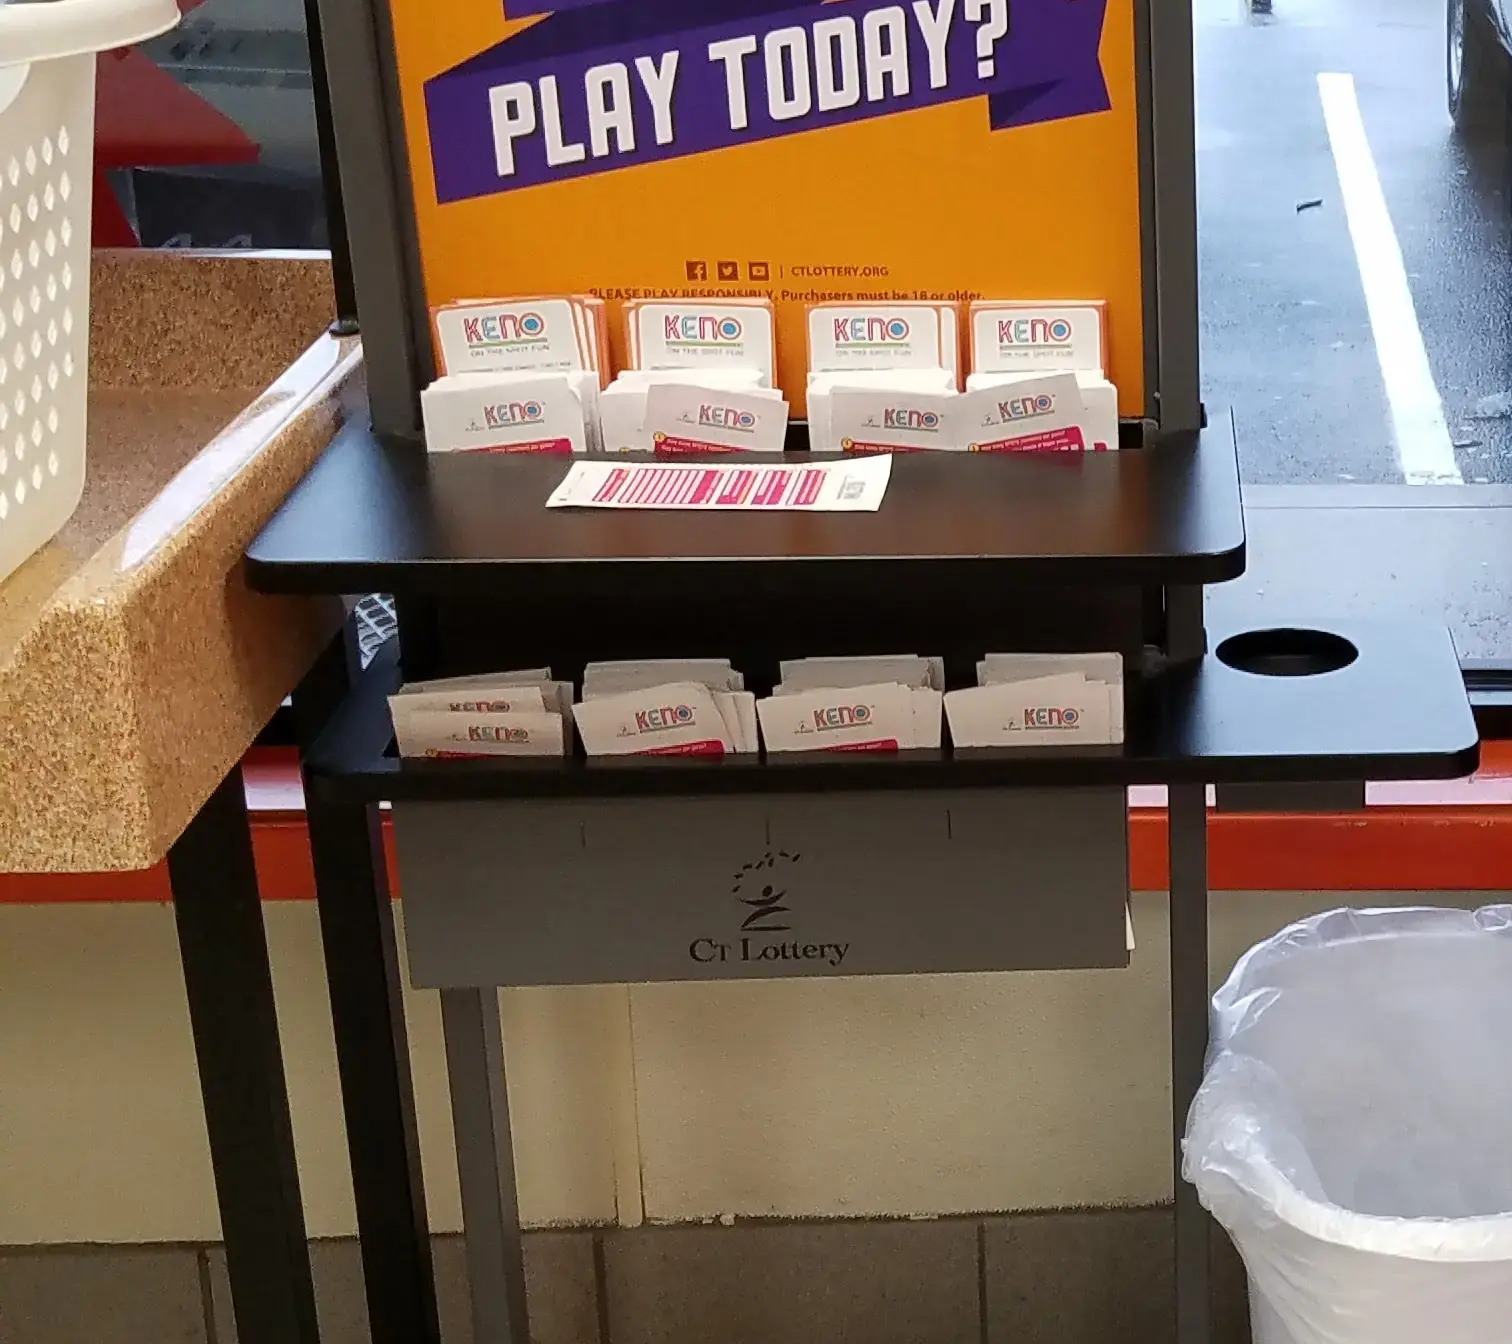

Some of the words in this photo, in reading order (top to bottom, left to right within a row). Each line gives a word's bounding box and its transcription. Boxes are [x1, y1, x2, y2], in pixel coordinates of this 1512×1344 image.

[488, 51, 680, 178] PLAY
[791, 266, 889, 277] CTLOTTERY.ORG
[589, 288, 641, 300] PLEASE
[781, 290, 851, 302] Purchasers
[856, 290, 889, 301] must
[892, 290, 908, 301] be
[912, 290, 928, 300] 18
[947, 289, 985, 301] older.
[463, 312, 544, 343] KENO
[664, 314, 742, 340] KENO
[834, 317, 910, 342] KENO
[998, 318, 1072, 343] KENO
[484, 401, 542, 425] KENO
[699, 404, 755, 427] KENO
[884, 408, 939, 428] KENO
[998, 394, 1053, 419] KENO
[635, 704, 694, 730] KENO
[813, 704, 871, 727] KENO
[1024, 707, 1079, 726] KENO
[741, 938, 849, 967] Lottery
